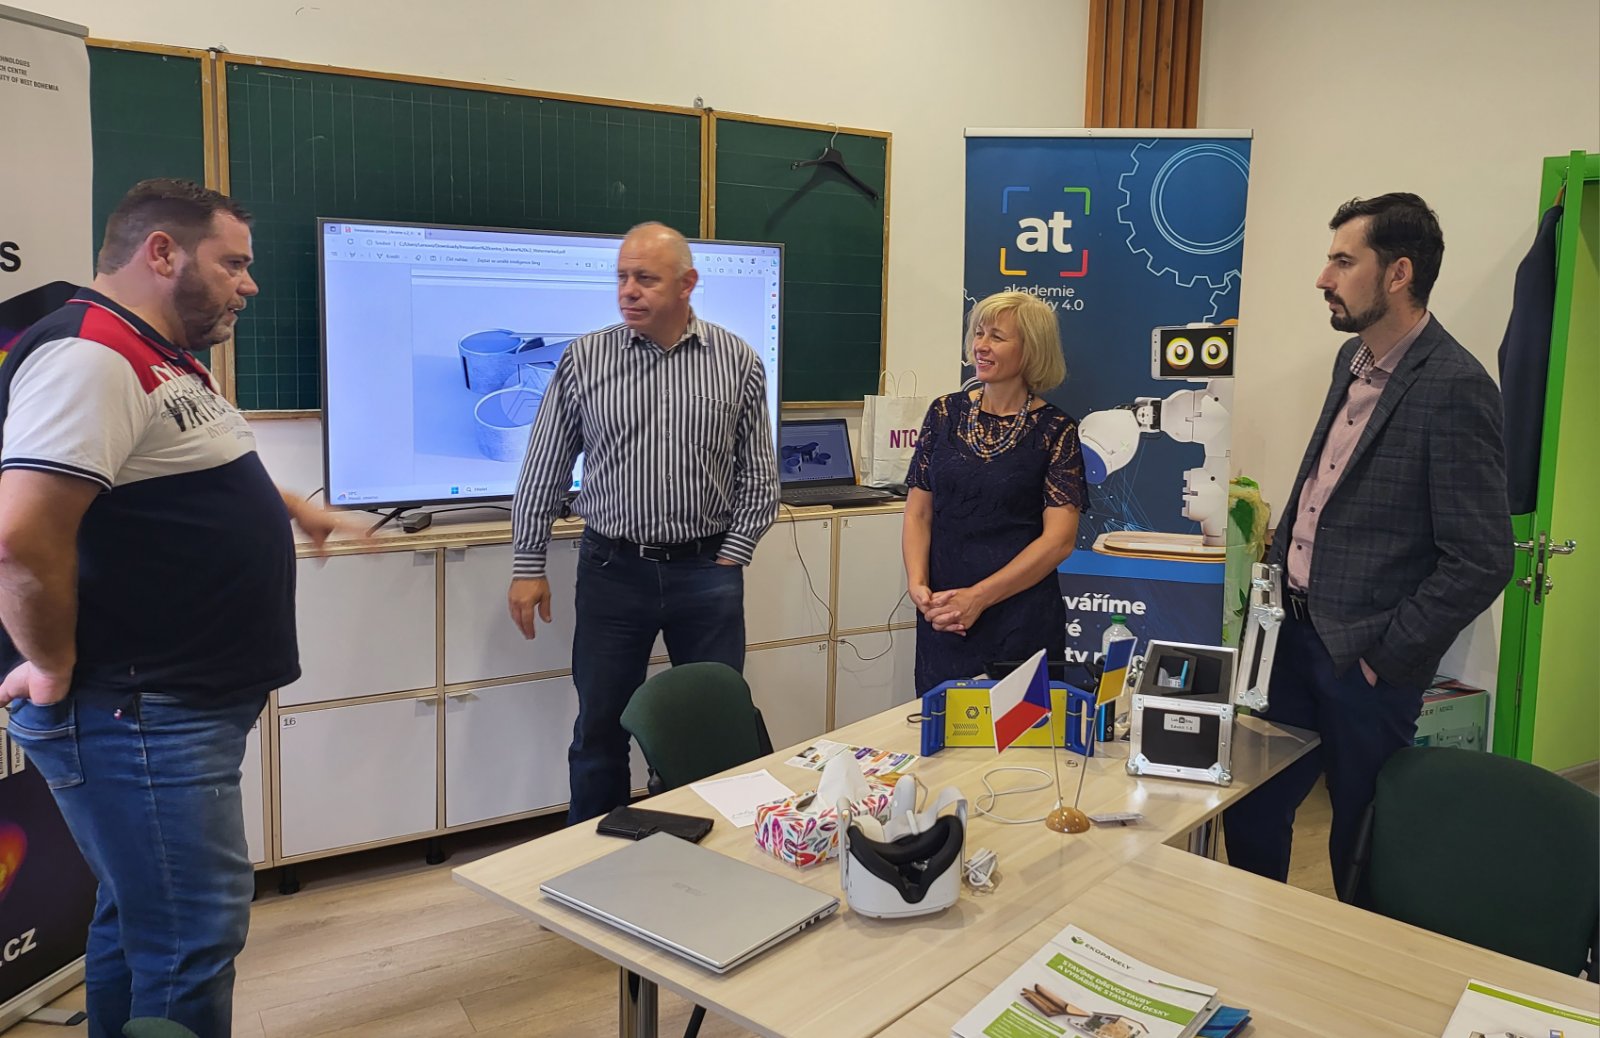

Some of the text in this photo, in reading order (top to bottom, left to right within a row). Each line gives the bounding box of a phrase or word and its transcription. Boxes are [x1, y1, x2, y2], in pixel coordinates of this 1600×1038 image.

[7, 66, 27, 75] CENTRE
[0, 74, 10, 82] ITY
[20, 78, 33, 86] WEST
[33, 81, 59, 91] BOHEMIA
[1015, 211, 1073, 253] at
[1003, 283, 1075, 297] akademie
[1061, 299, 1084, 311] 4.0
[890, 429, 918, 448] NTC
[843, 519, 849, 527] 7
[1062, 593, 1147, 615] váříme
[1065, 619, 1082, 637] é
[983, 706, 991, 715] T
[283, 718, 297, 727] 16
[1084, 943, 1132, 970] EKOPANELY
[1142, 1005, 1169, 1017] DESKY
